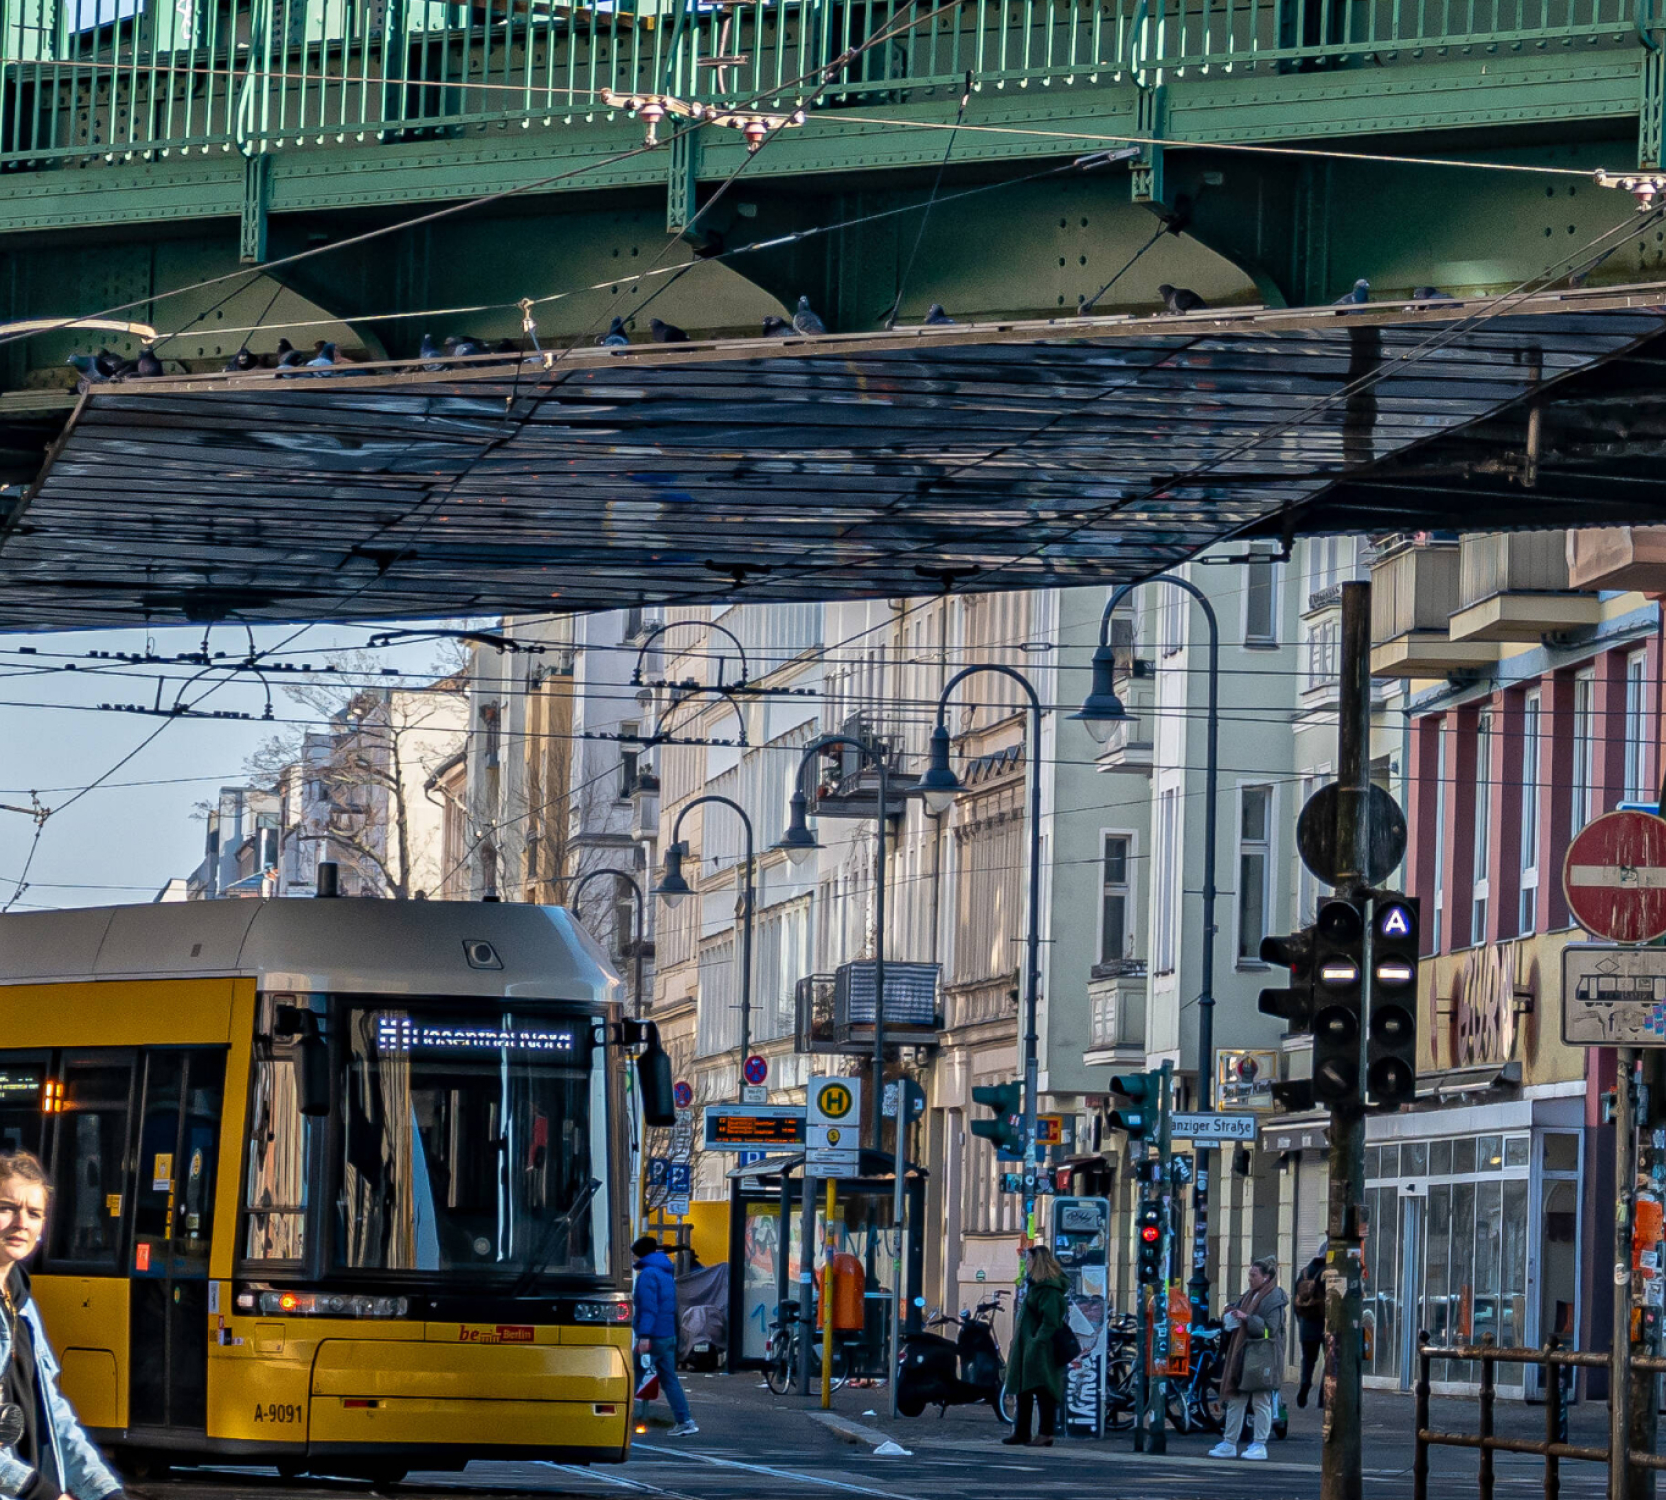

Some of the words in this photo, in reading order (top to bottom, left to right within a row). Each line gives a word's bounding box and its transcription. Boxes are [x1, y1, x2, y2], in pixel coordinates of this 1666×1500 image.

[1385, 910, 1407, 935] A
[1171, 1119, 1210, 1135] anziger
[1213, 1119, 1251, 1135] Straße
[459, 1325, 480, 1342] be
[503, 1329, 532, 1341] Berlin
[253, 1402, 303, 1423] A-9091
